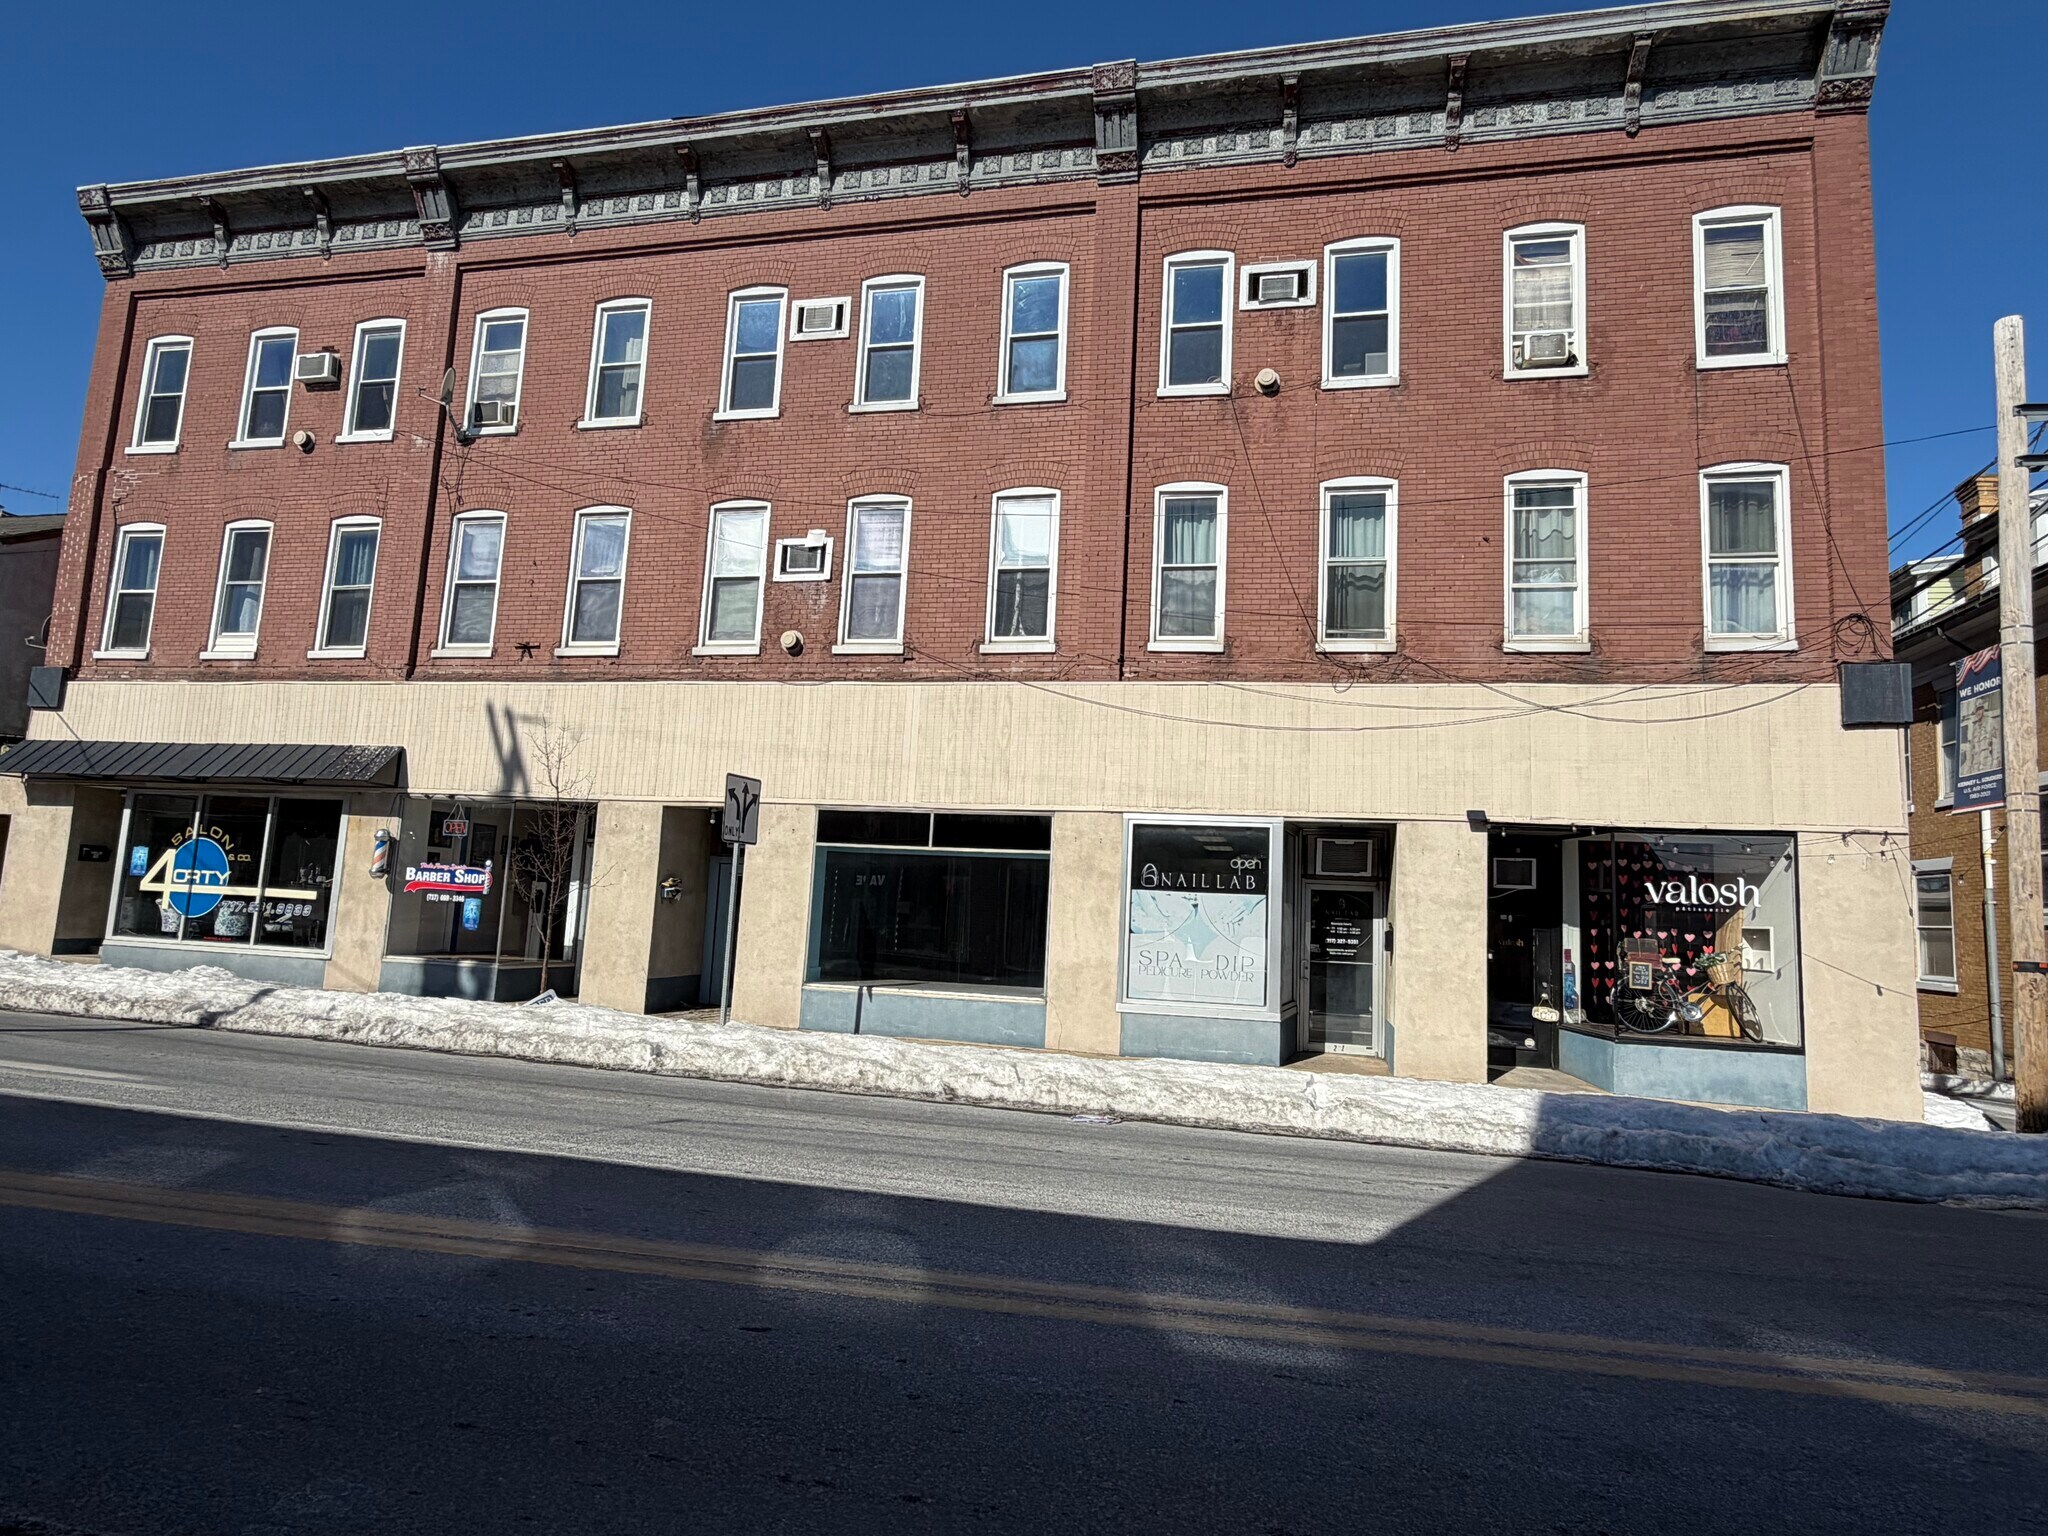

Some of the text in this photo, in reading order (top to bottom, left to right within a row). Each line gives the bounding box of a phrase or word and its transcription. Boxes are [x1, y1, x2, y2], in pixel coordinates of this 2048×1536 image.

[1959, 676, 2002, 698] WE HONOR
[444, 821, 466, 834] OPEN
[725, 824, 739, 837] ONLY
[171, 824, 235, 851] SALON
[227, 853, 235, 861] &
[405, 866, 451, 883] BARBER
[454, 869, 486, 884] SHOP
[1230, 857, 1262, 876] open
[1644, 875, 1762, 908] valosh
[1139, 950, 1183, 968] SPA
[1216, 954, 1255, 972] DIP
[1138, 965, 1193, 979] PEDICURE
[1201, 969, 1254, 982] POWDER
